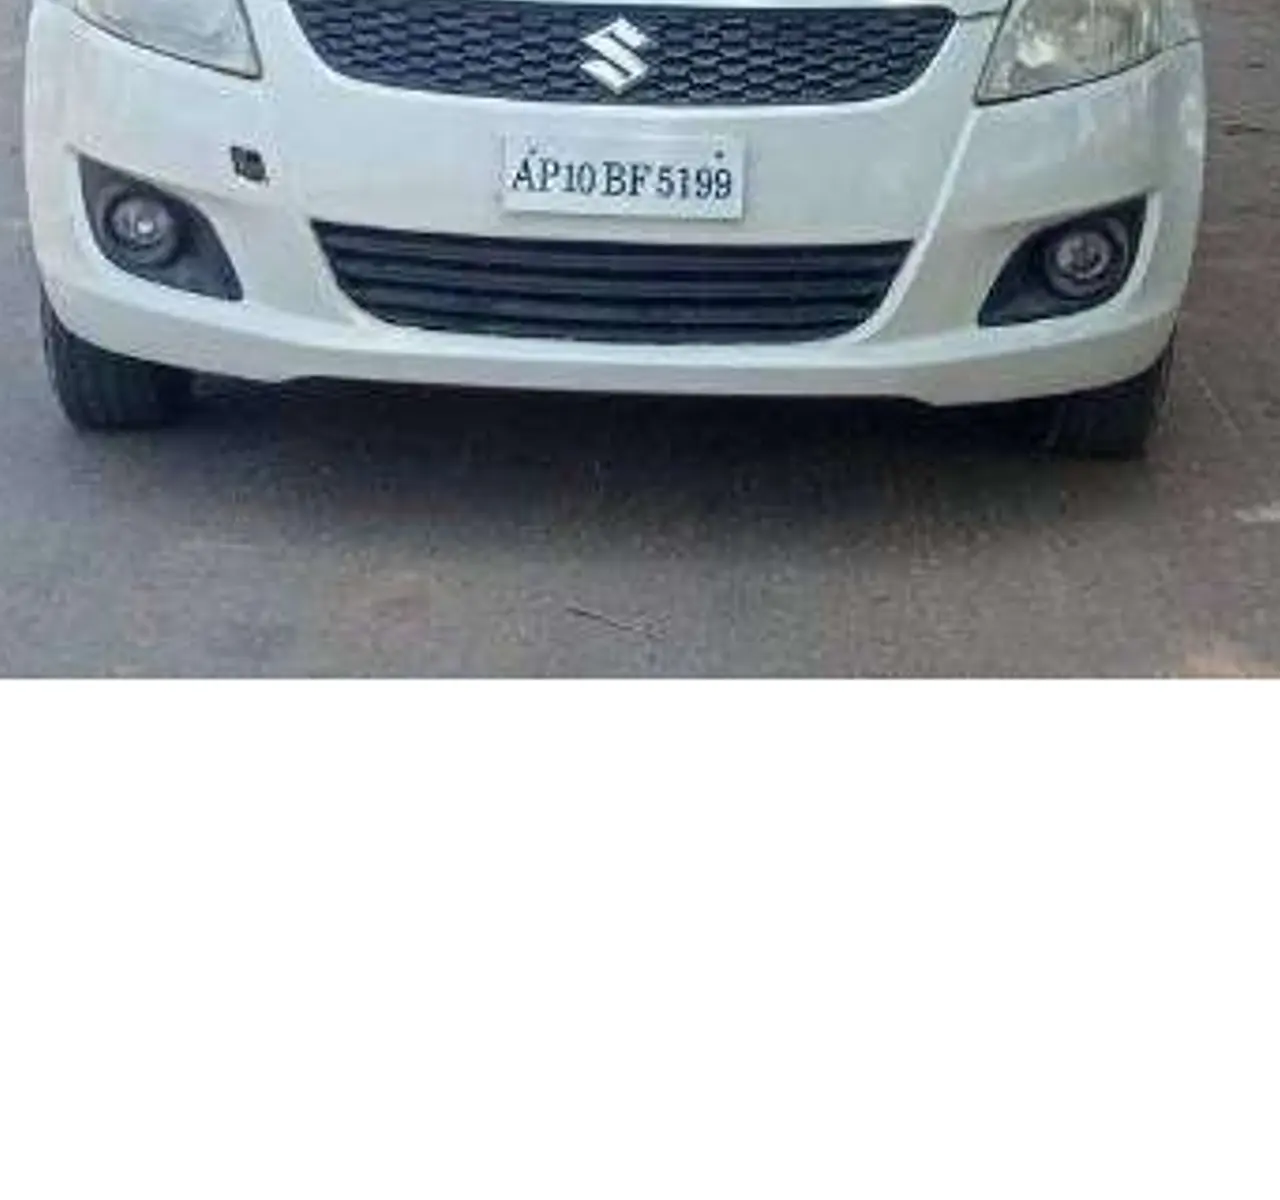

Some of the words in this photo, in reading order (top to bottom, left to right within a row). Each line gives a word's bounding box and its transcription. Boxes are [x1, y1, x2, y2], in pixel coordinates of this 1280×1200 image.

[513, 157, 596, 194] AP10
[602, 161, 651, 196] BF
[656, 166, 732, 199] 5199
